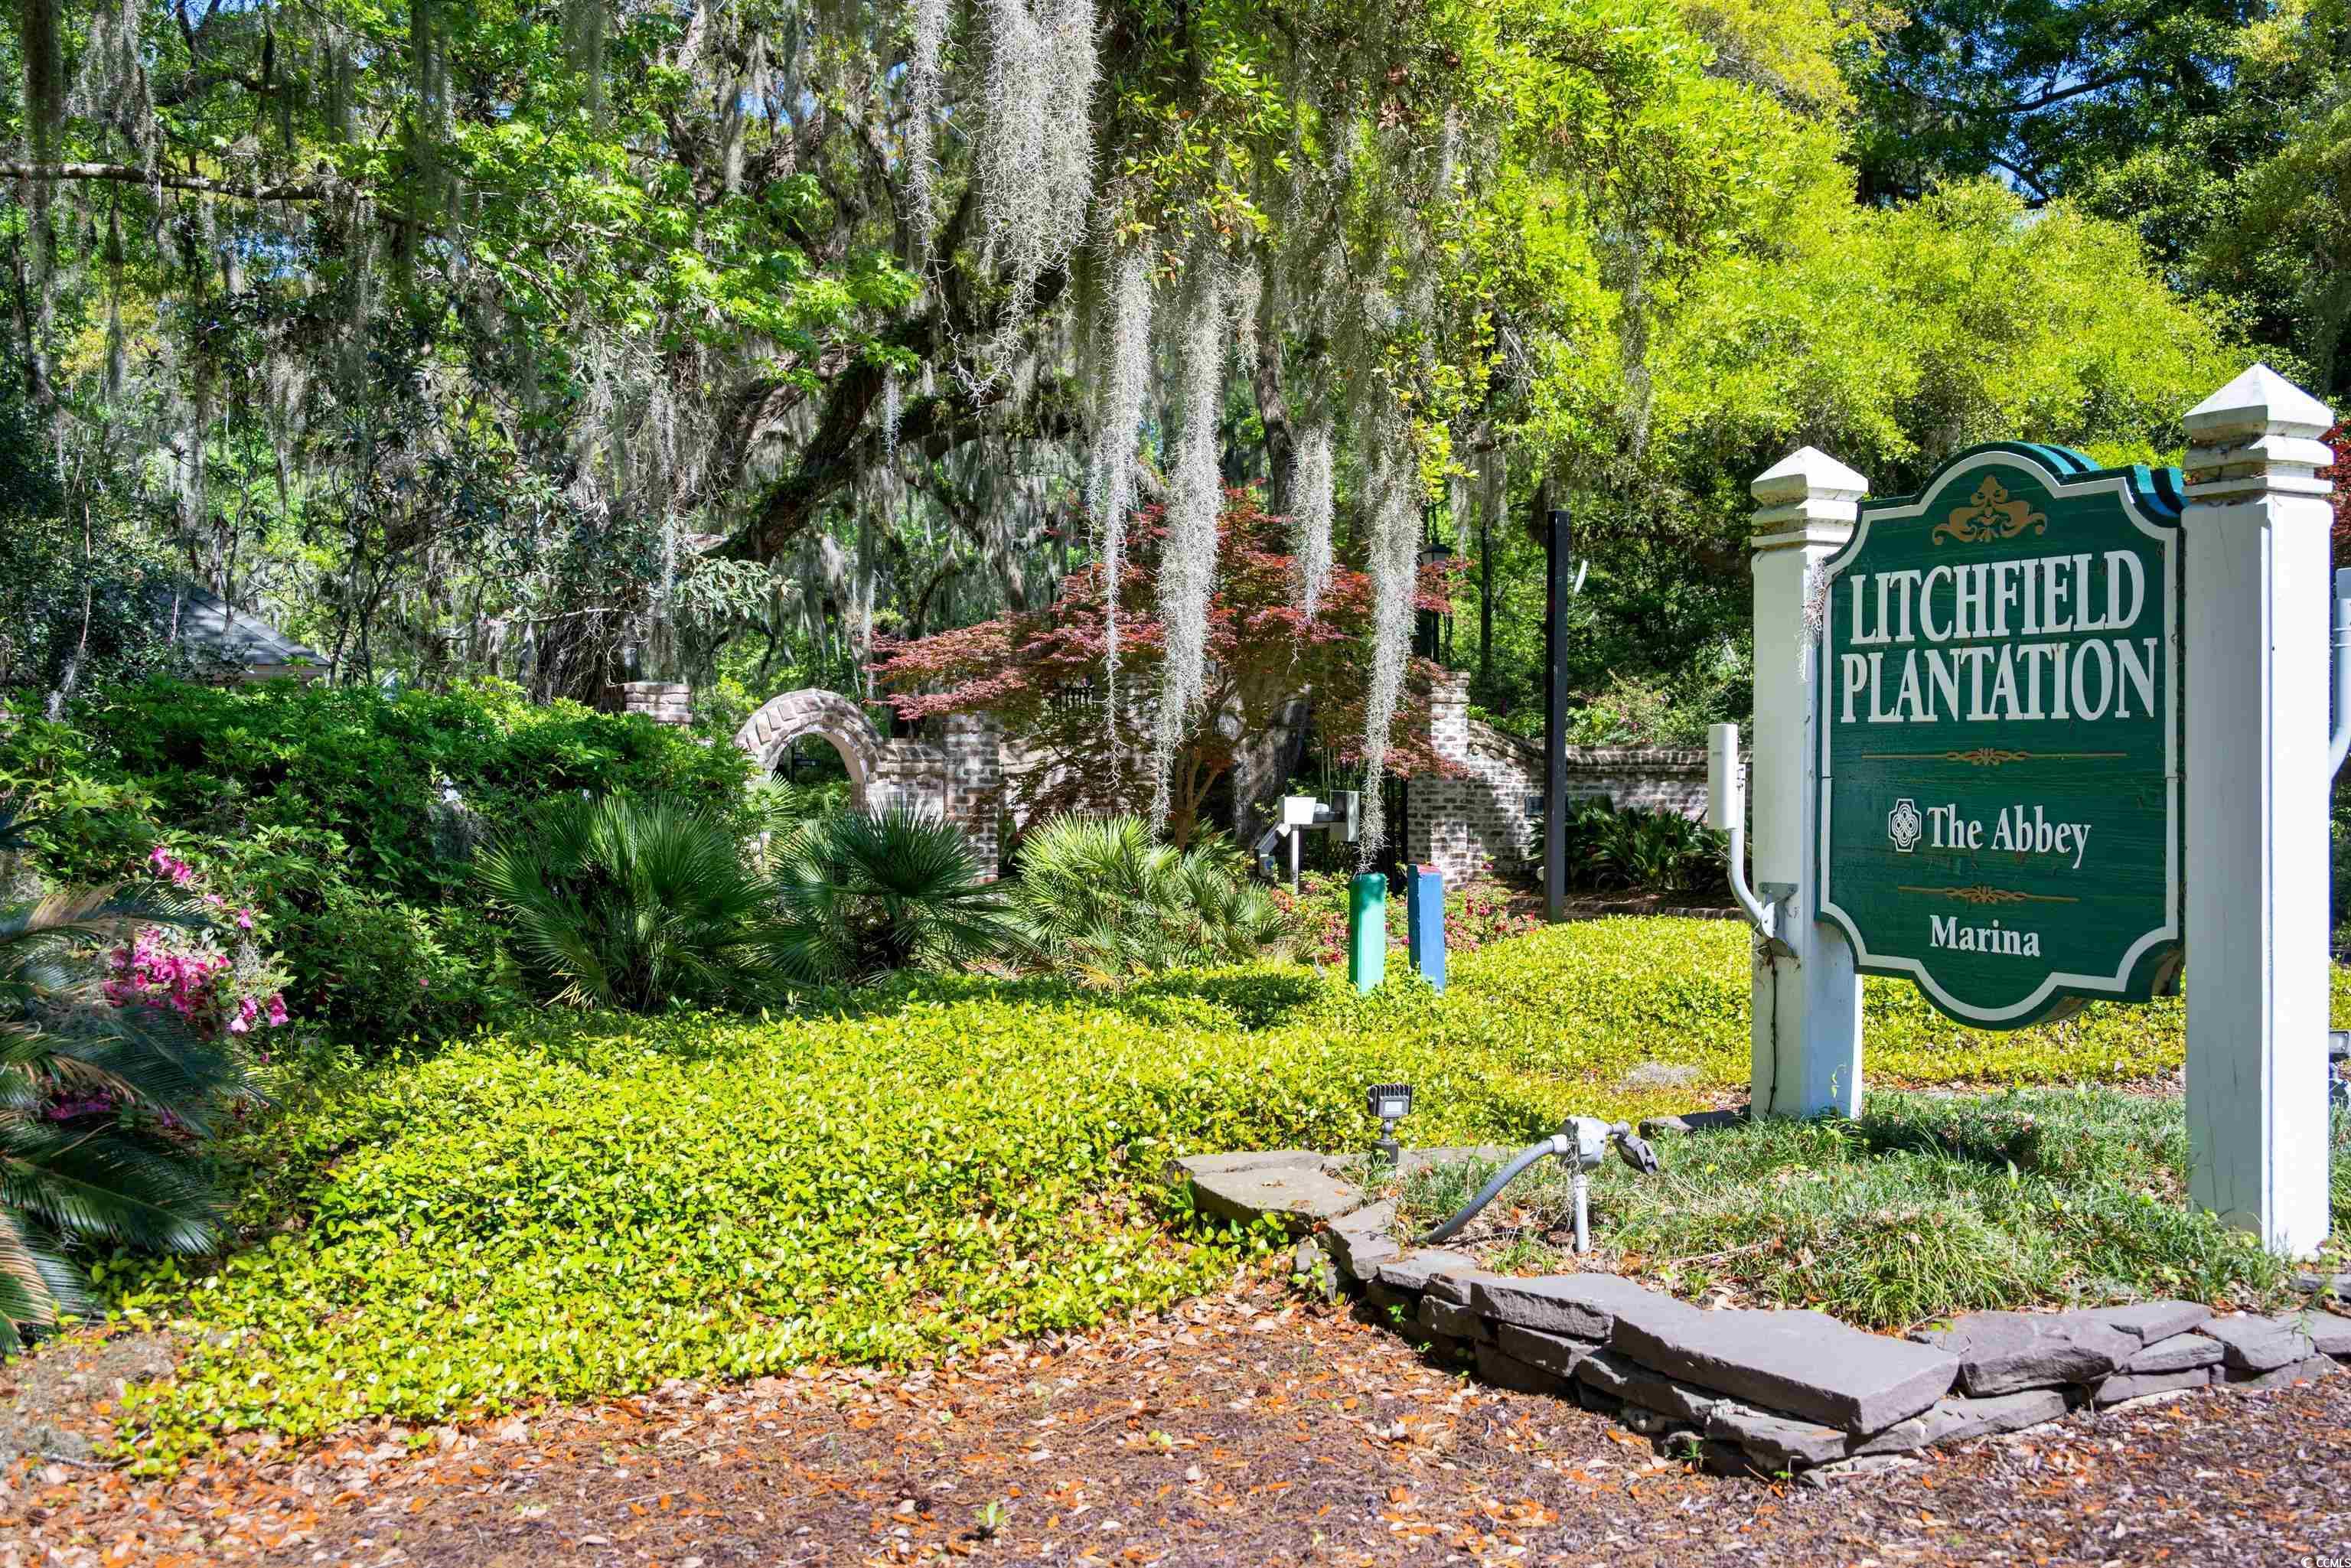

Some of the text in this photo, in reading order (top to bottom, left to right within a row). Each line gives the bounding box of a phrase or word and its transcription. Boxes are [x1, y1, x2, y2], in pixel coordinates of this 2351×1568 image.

[1850, 549, 2145, 645] LITCHFIELD
[1841, 637, 2158, 723] PLANTATION
[1926, 804, 2092, 869] The Abbey
[1930, 915, 2041, 957] Marina
